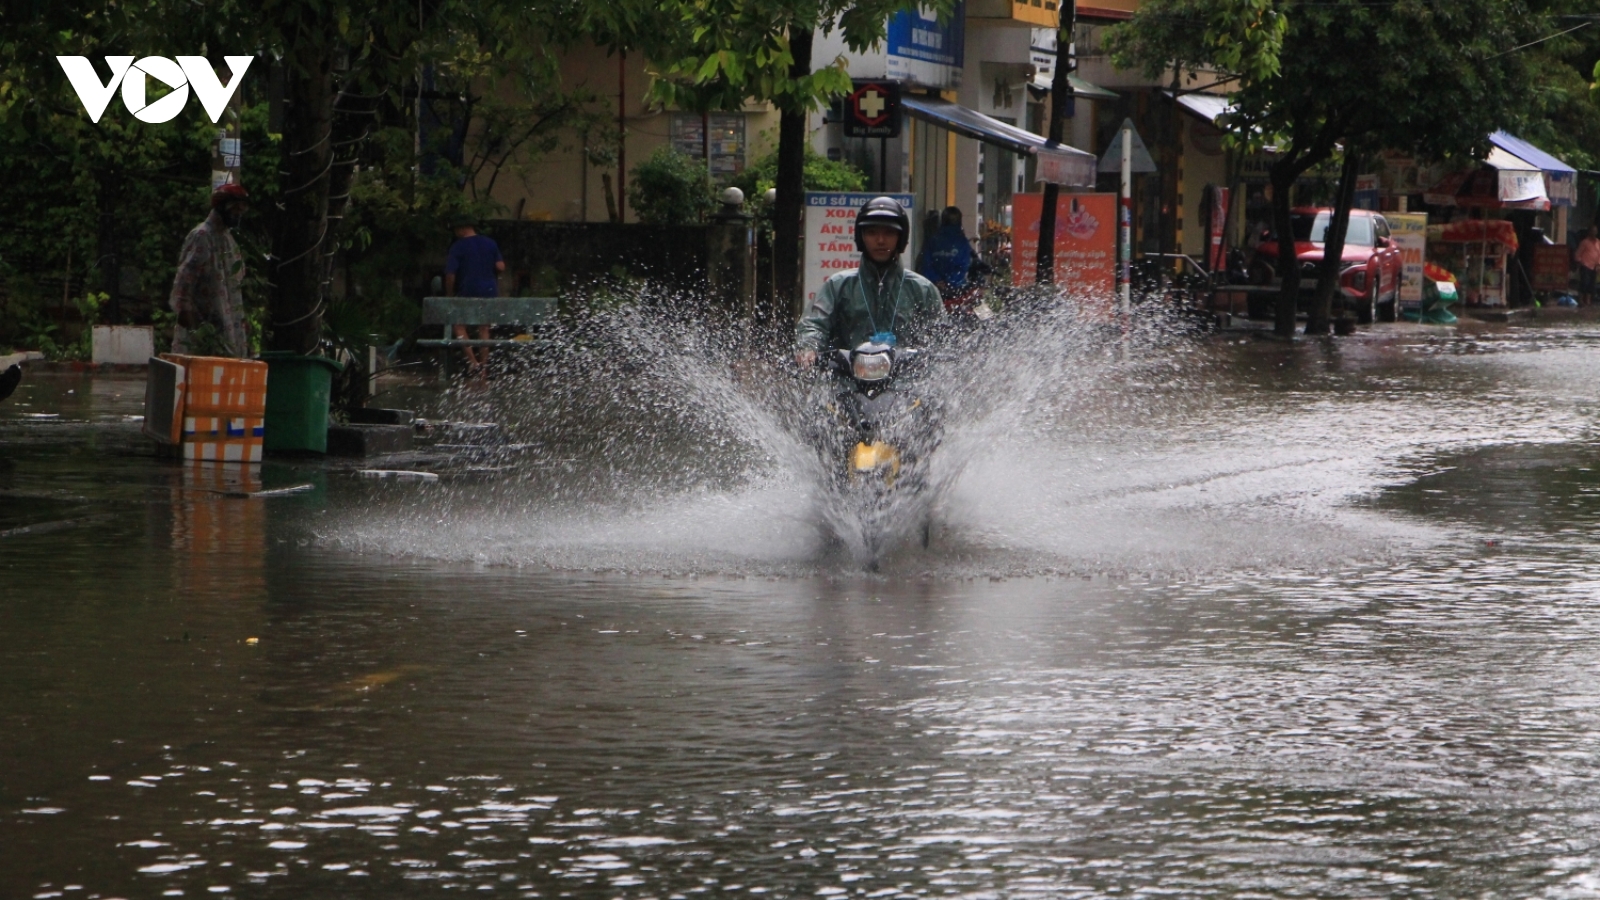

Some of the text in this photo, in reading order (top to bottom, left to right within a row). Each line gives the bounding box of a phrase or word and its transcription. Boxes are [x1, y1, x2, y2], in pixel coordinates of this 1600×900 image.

[867, 126, 892, 135] Family
[810, 196, 827, 205] CƠ
[830, 194, 847, 206] SỞ
[825, 208, 857, 218] XOA
